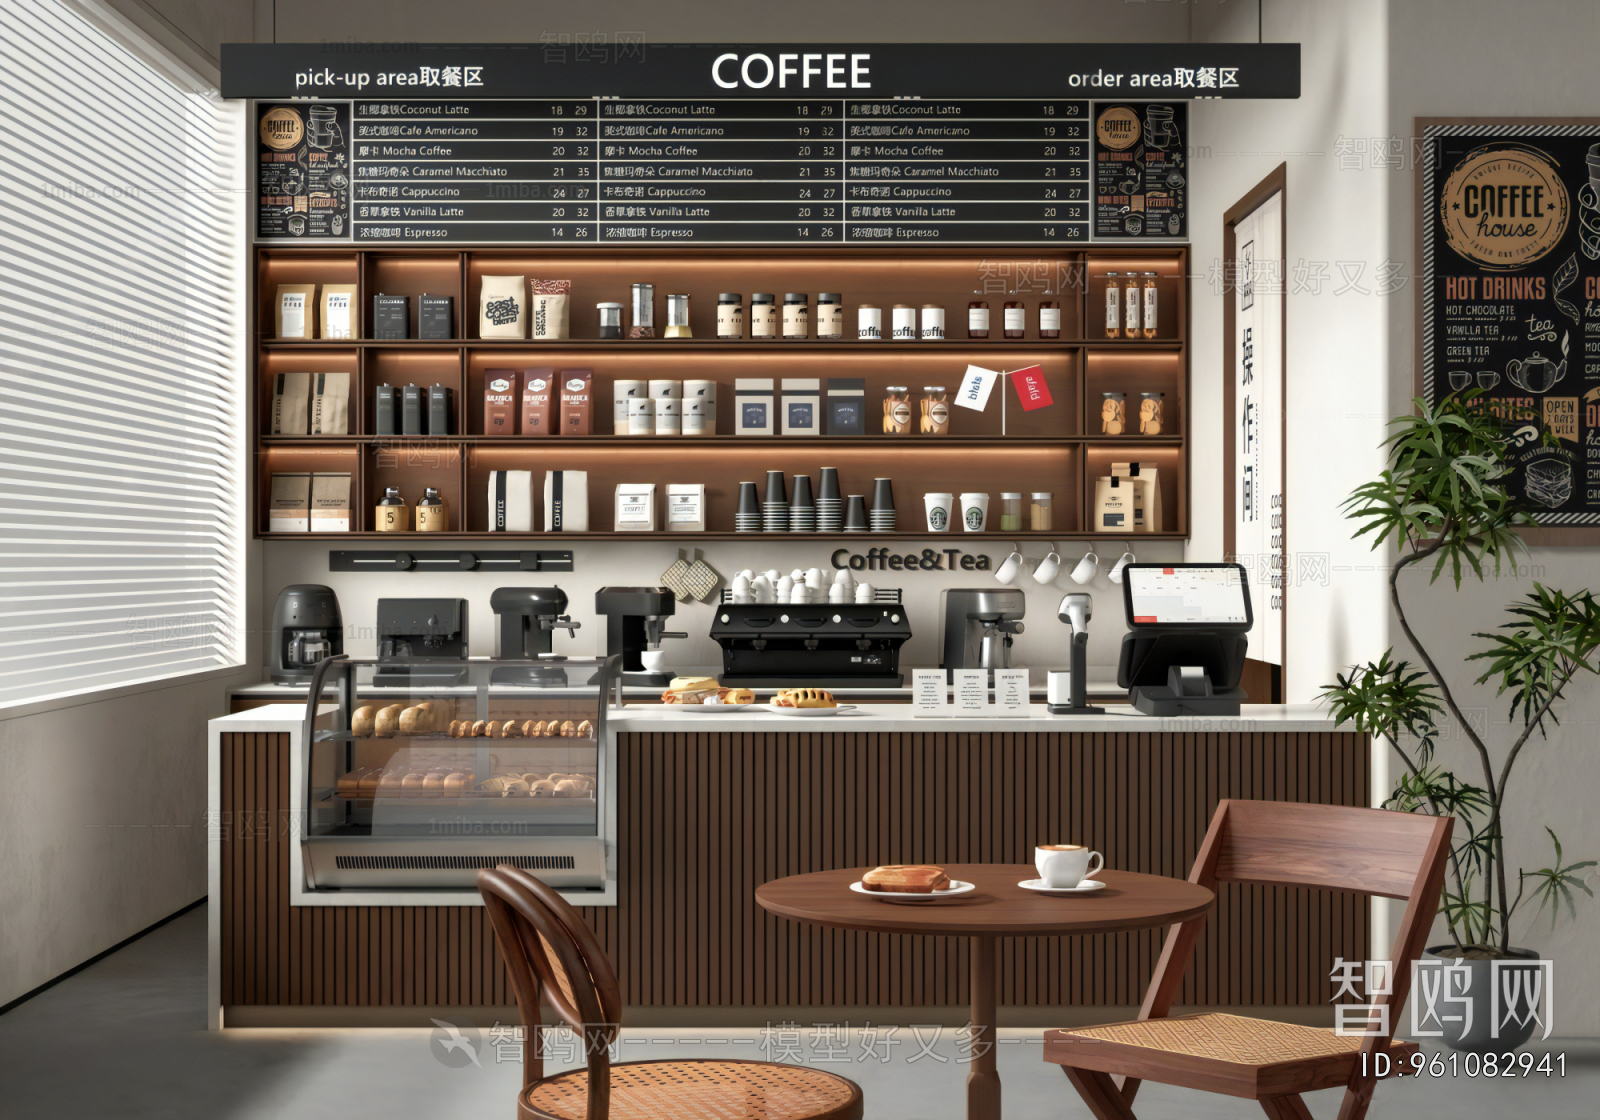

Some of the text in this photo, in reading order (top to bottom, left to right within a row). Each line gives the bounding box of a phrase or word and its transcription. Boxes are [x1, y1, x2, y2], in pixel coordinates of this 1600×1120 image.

[711, 53, 871, 89] COFFEE
[295, 68, 370, 91] pick-up
[1068, 69, 1124, 88] order
[551, 105, 563, 114] 18
[574, 105, 588, 115] 29
[797, 105, 809, 115] 18
[820, 105, 833, 115] 29
[1043, 105, 1055, 115] 18
[1066, 105, 1079, 115] 29
[552, 126, 564, 135] 19
[576, 126, 588, 135] 32
[798, 126, 810, 135] 19
[1044, 126, 1056, 136] 19
[1067, 126, 1080, 136] 32
[383, 145, 417, 155] Mocha
[552, 146, 565, 155] 20
[577, 146, 589, 155] 32
[629, 145, 663, 155] Mocha
[798, 146, 811, 155] 20
[823, 146, 835, 155] 32
[875, 145, 909, 155] Mocha
[1044, 146, 1057, 155] 20
[1069, 146, 1081, 155] 32
[553, 167, 564, 176] 21
[578, 167, 590, 176] 35
[799, 167, 810, 176] 21
[824, 167, 836, 176] 35
[1044, 167, 1056, 176] 21
[1069, 167, 1081, 176] 35
[553, 188, 566, 198] 24
[577, 188, 590, 198] 27
[799, 188, 811, 198] 24
[823, 188, 836, 198] 27
[1044, 188, 1057, 198] 24
[1069, 188, 1081, 198] 27
[1464, 184, 1545, 218] COFFEE
[552, 207, 565, 216] 20
[577, 207, 589, 216] 32
[798, 207, 811, 216] 20
[823, 207, 835, 216] 32
[1044, 207, 1057, 216] 20
[1068, 207, 1081, 216] 32
[1476, 212, 1538, 237] house
[551, 227, 564, 236] 14
[575, 227, 588, 237] 26
[797, 227, 809, 236] 14
[821, 227, 834, 236] 26
[1043, 227, 1055, 236] 14
[1067, 227, 1080, 236] 26
[1446, 276, 1546, 300] HOT DRINKS
[1446, 305, 1515, 315] HOT CHOCOLATE
[1525, 313, 1555, 333] tea
[1484, 325, 1499, 335] TEA
[1446, 346, 1490, 356] GREEN TEA
[1546, 400, 1575, 414] OPEN
[387, 512, 394, 523] 5
[420, 512, 426, 523] 5
[831, 547, 991, 571] Coffee&Tea
